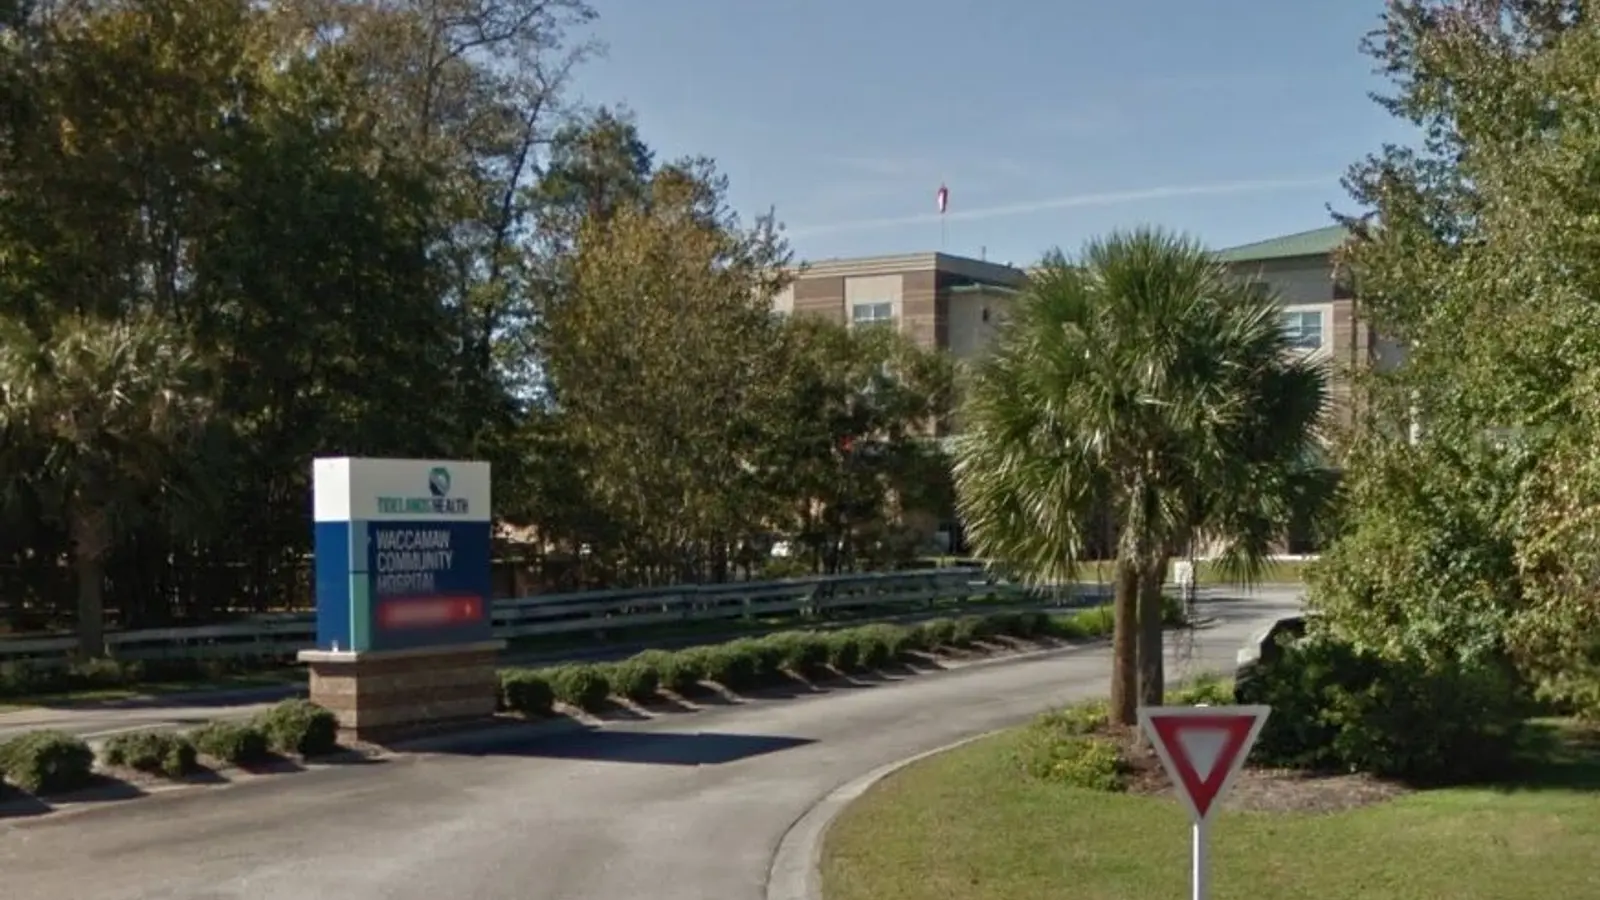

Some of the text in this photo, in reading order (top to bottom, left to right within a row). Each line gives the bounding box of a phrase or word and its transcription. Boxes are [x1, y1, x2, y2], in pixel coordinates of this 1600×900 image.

[431, 497, 469, 514] HEALTH
[376, 529, 451, 549] WACCAMAW
[377, 551, 453, 571] COMMUNITY
[377, 573, 435, 593] HOSPITAL
